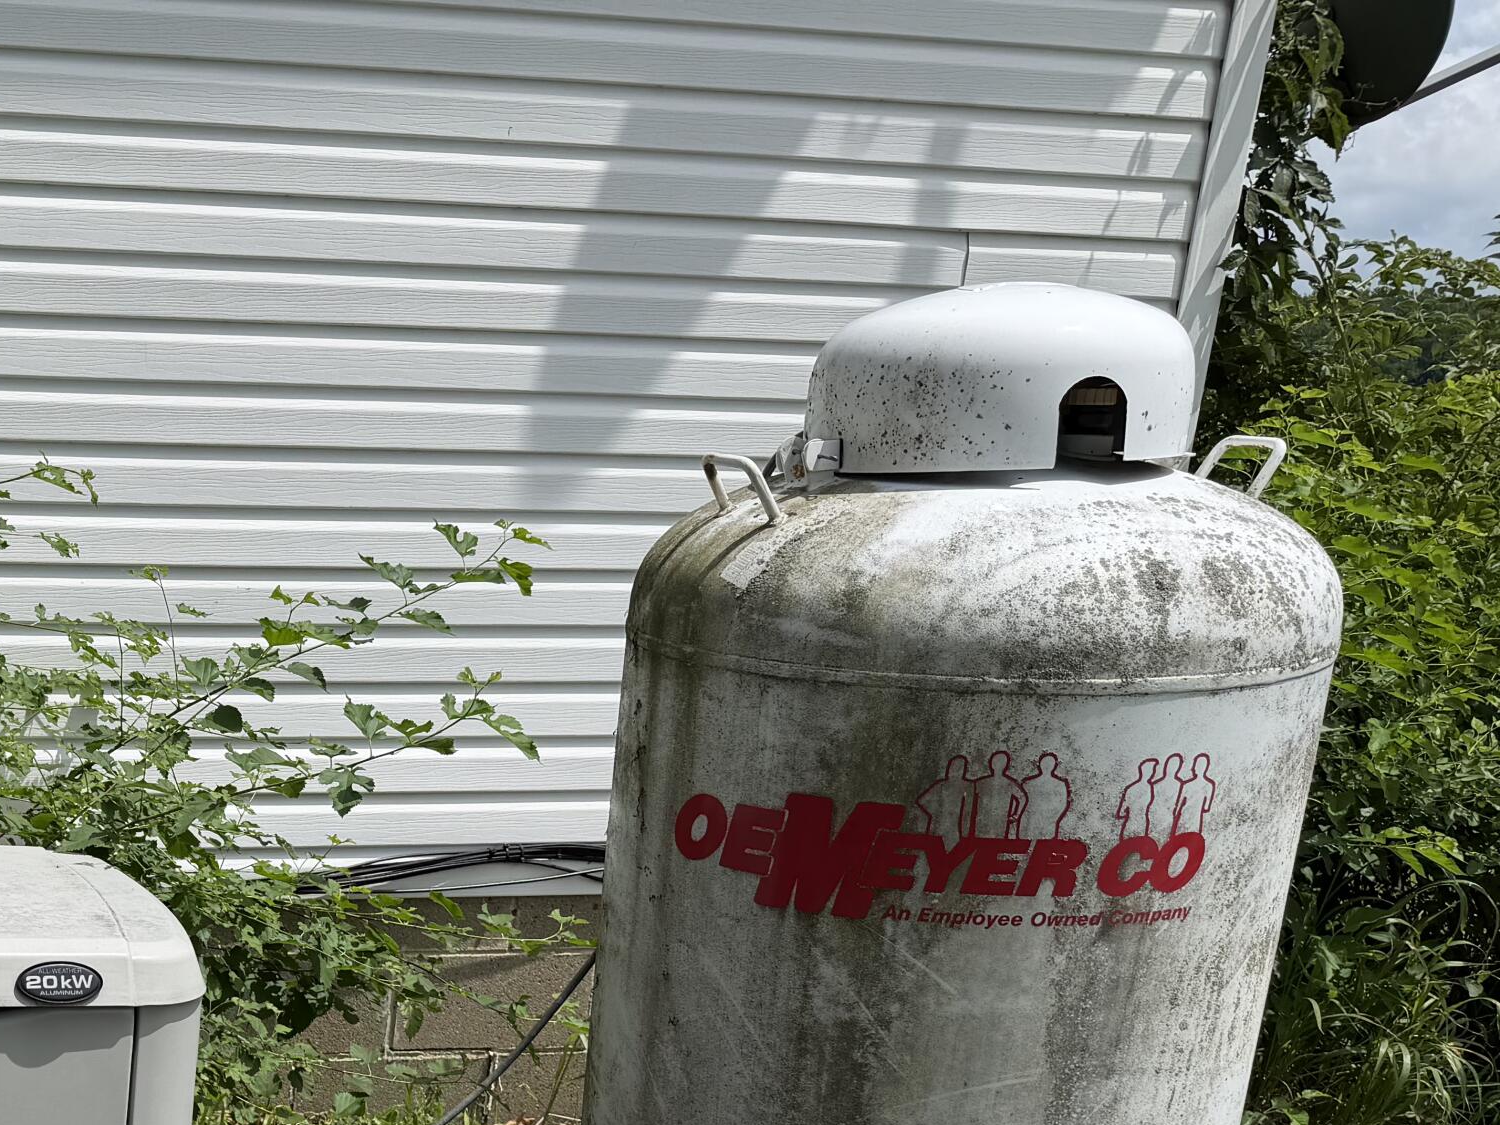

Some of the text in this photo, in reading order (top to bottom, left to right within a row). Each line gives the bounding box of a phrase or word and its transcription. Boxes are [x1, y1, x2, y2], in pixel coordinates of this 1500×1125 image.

[1095, 832, 1206, 897] CO
[882, 904, 1192, 928] An Employee Owned Company
